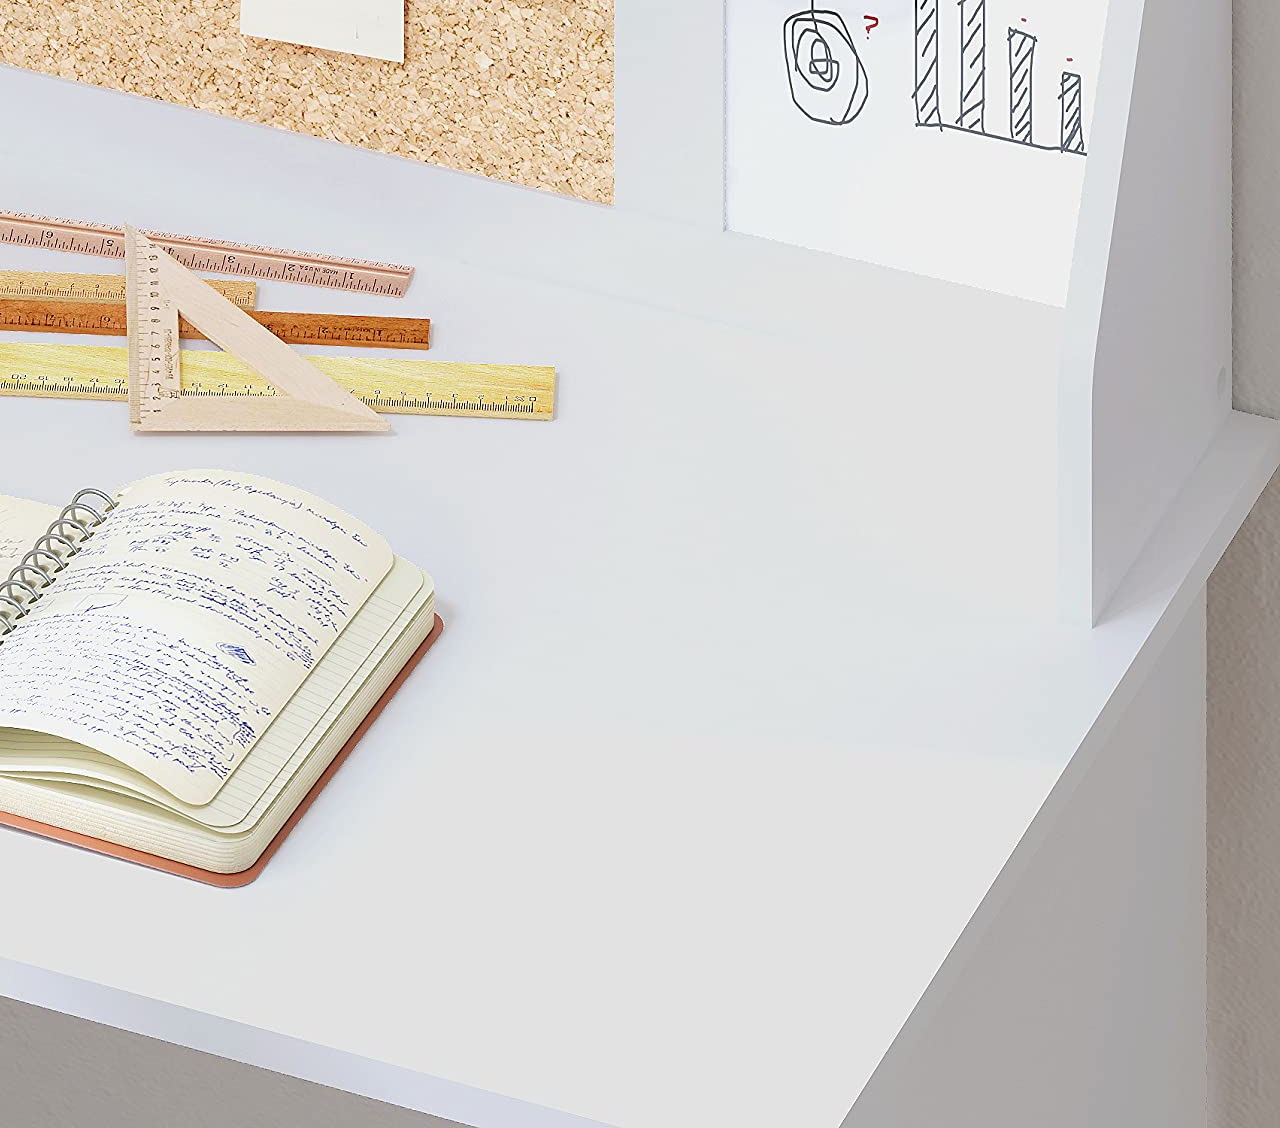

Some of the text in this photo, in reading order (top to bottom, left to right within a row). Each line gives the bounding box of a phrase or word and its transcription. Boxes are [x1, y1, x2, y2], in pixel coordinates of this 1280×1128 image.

[44, 230, 53, 239] 6
[105, 238, 114, 247] 5
[225, 254, 236, 263] 3
[287, 262, 297, 272] 2
